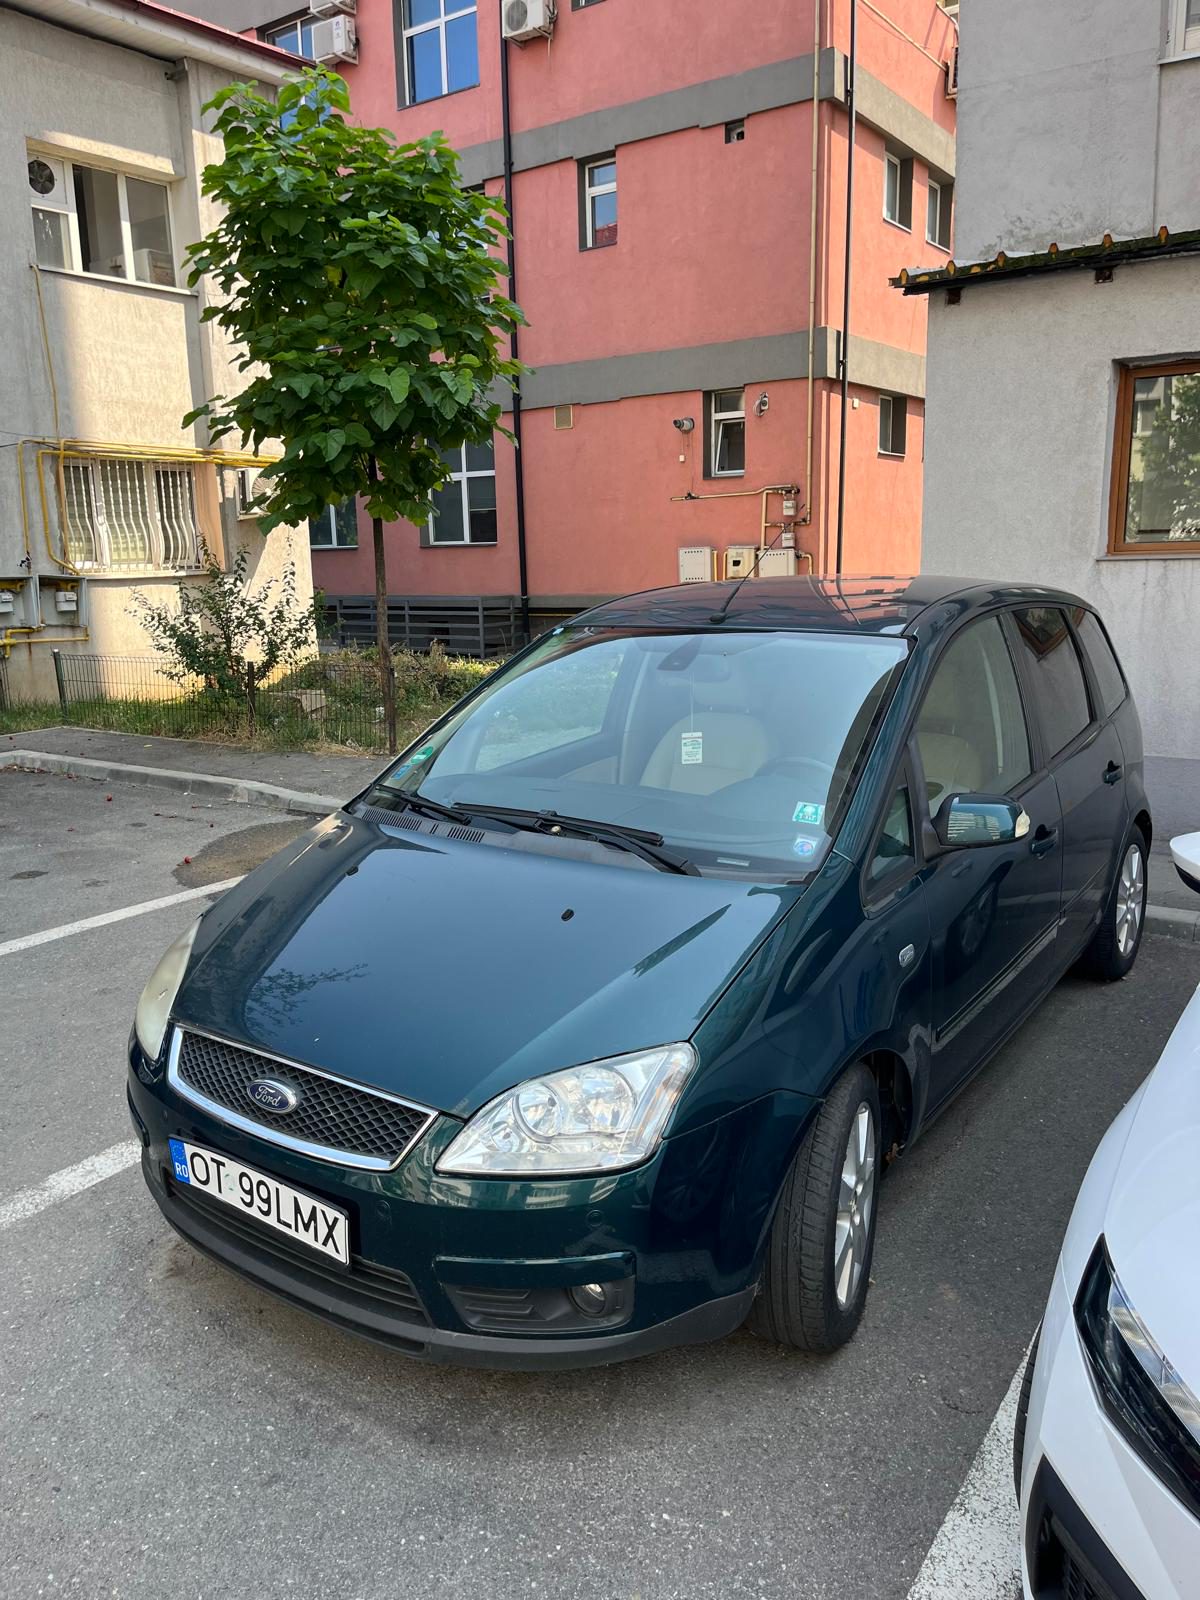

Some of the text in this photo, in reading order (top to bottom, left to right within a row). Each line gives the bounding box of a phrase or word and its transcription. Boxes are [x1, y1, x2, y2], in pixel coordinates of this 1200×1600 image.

[255, 1085, 282, 1107] Ford
[175, 1162, 189, 1178] RO
[189, 1151, 226, 1194] OT
